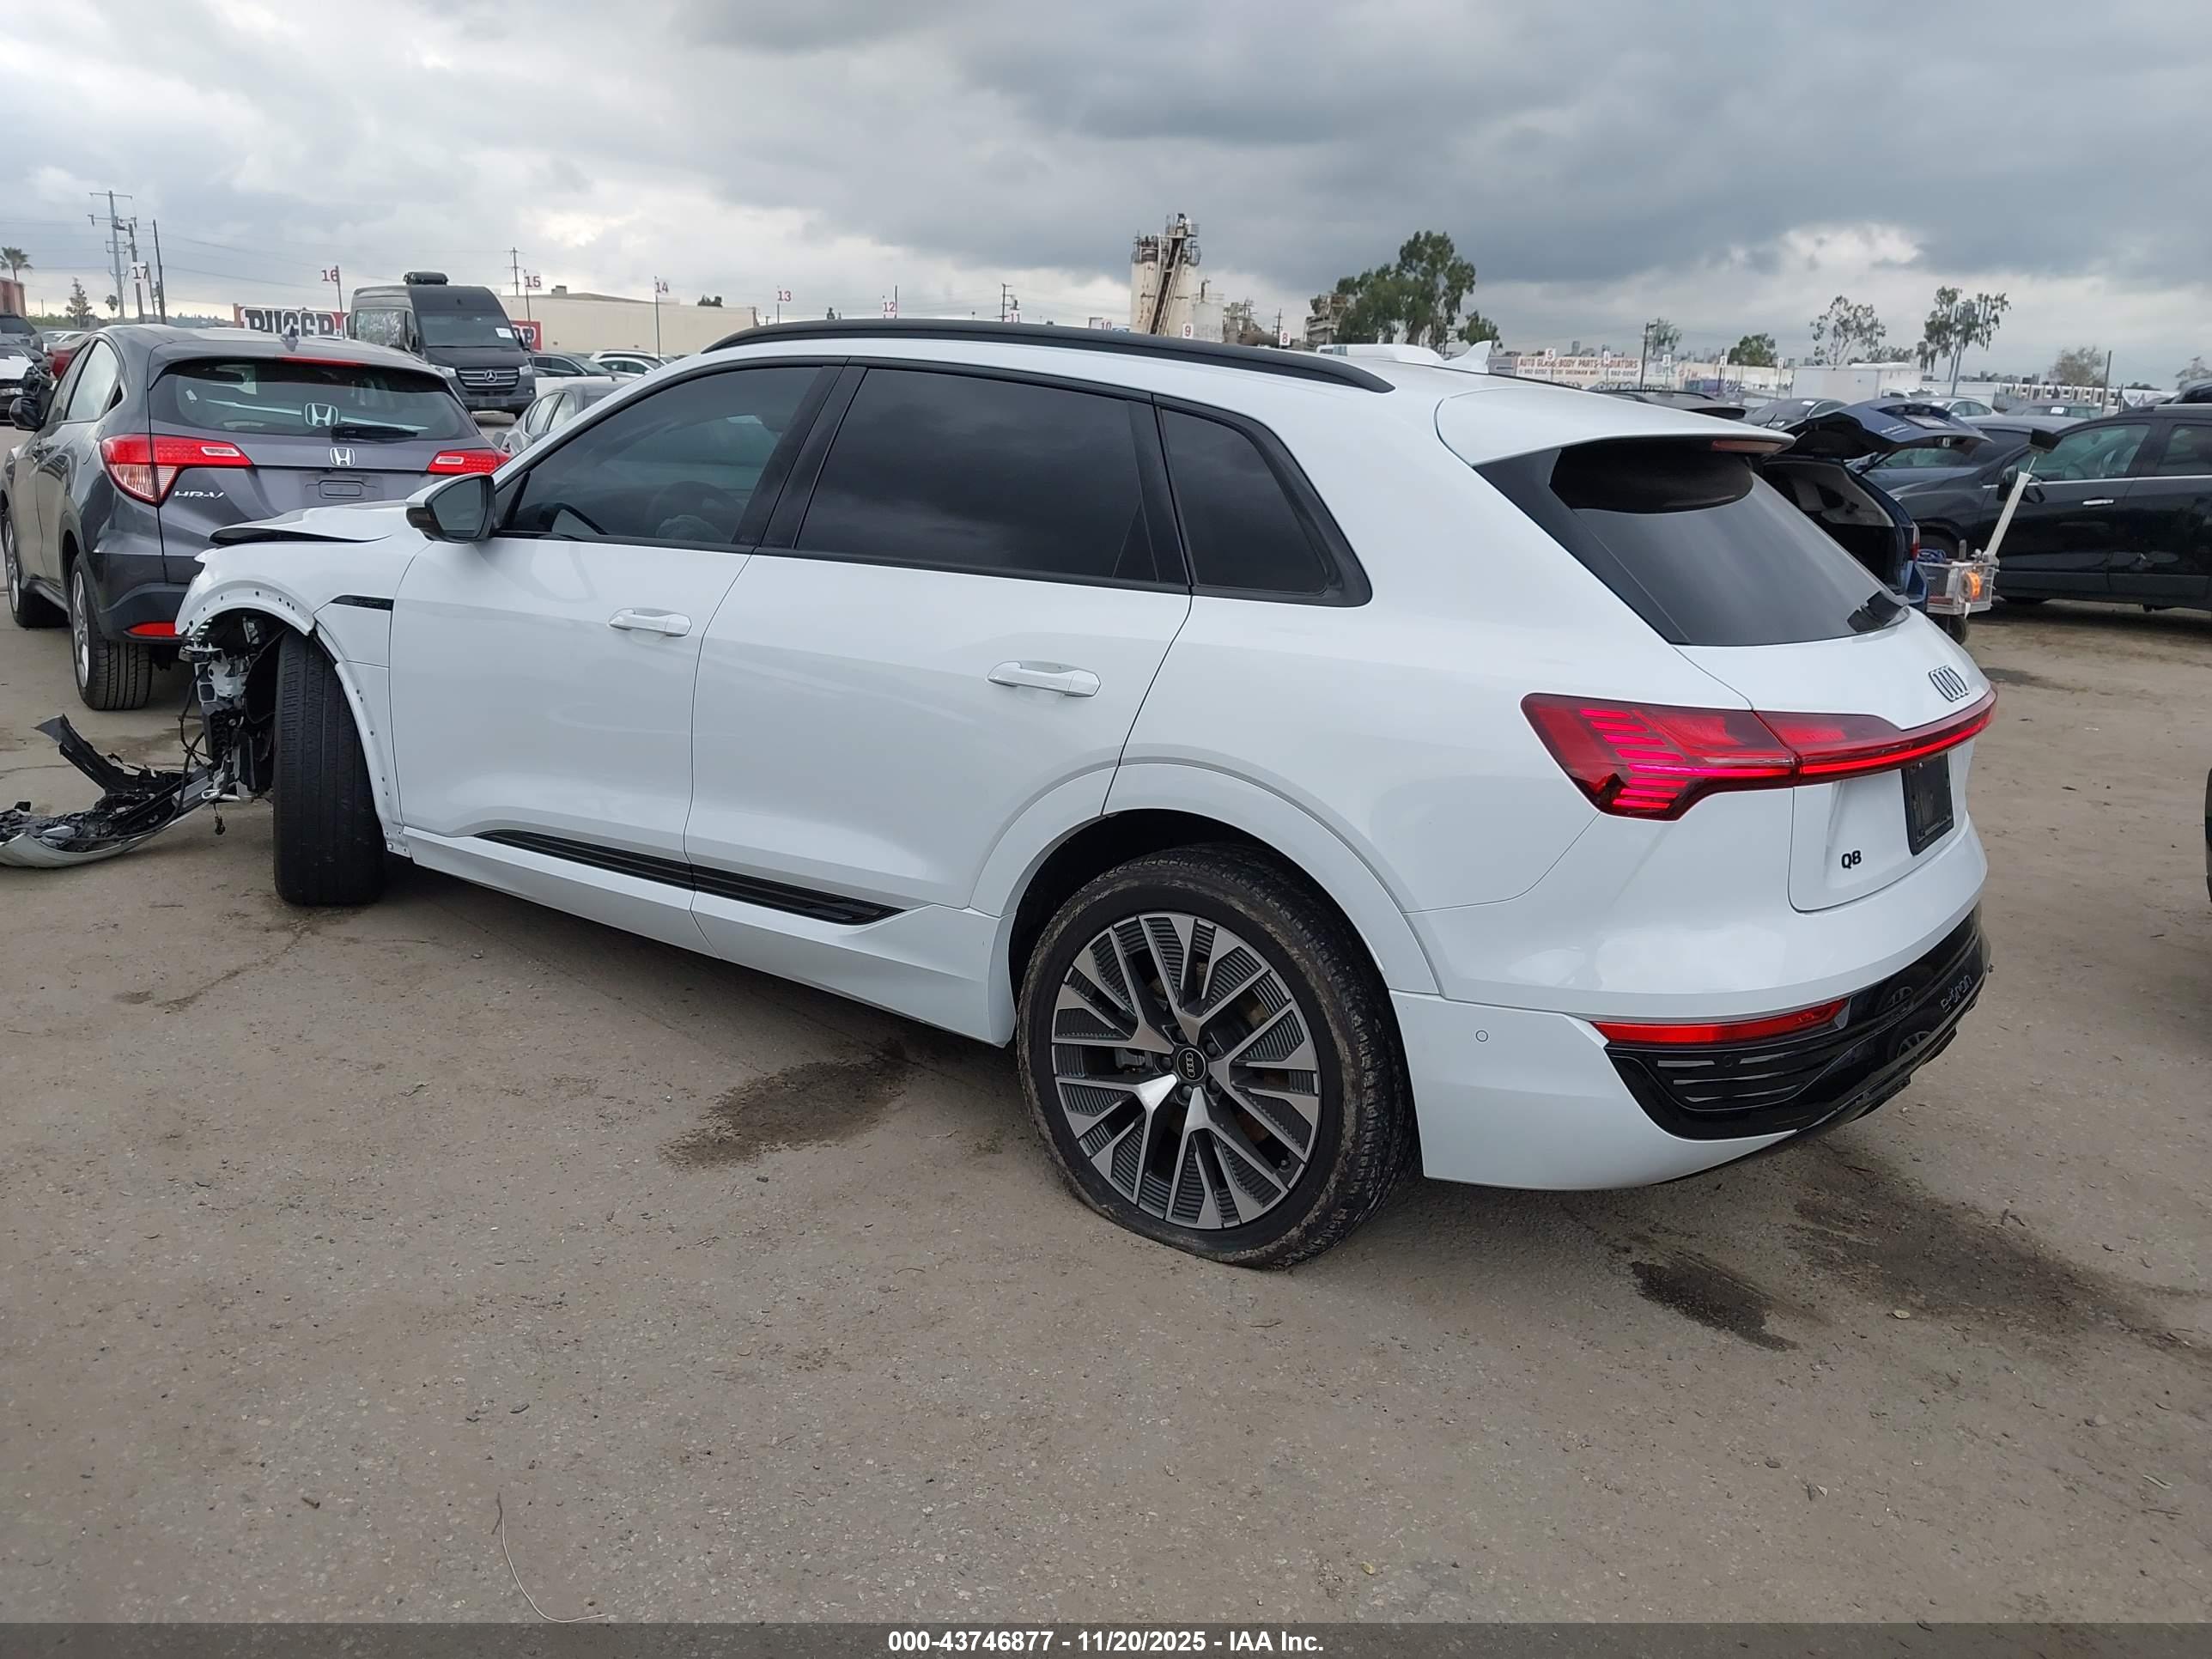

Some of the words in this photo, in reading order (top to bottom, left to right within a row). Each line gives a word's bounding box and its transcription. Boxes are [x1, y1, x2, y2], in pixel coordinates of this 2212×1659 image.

[131, 266, 148, 279] 17
[321, 270, 338, 282] 16
[525, 276, 541, 288] 15
[655, 281, 669, 293] 14
[777, 290, 791, 301] 13
[883, 301, 896, 312] 12
[1101, 320, 1112, 330] 10
[1184, 325, 1192, 337] 9
[1281, 332, 1288, 343] 8
[1547, 349, 1553, 360] 5
[174, 490, 225, 499] HR-V
[1841, 850, 1863, 870] Q8
